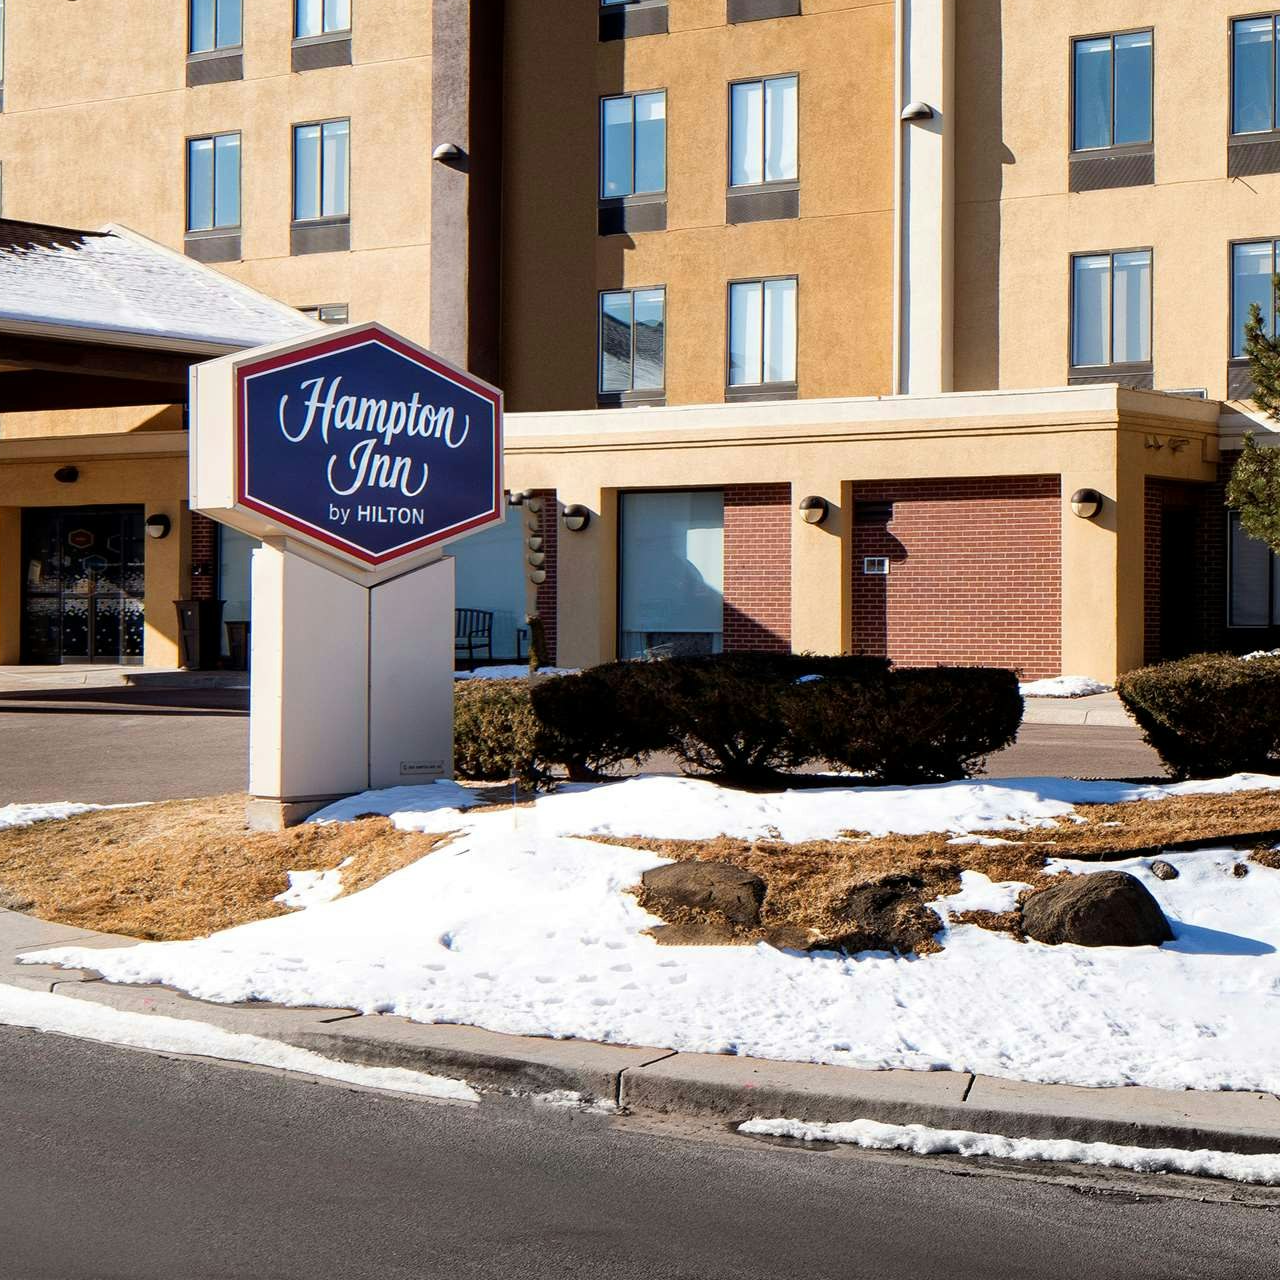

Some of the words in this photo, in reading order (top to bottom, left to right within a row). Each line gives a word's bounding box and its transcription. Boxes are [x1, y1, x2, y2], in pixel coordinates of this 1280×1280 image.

[279, 376, 469, 448] Hampton
[327, 439, 428, 497] Inn
[329, 503, 351, 525] by
[357, 505, 424, 525] HILTON
